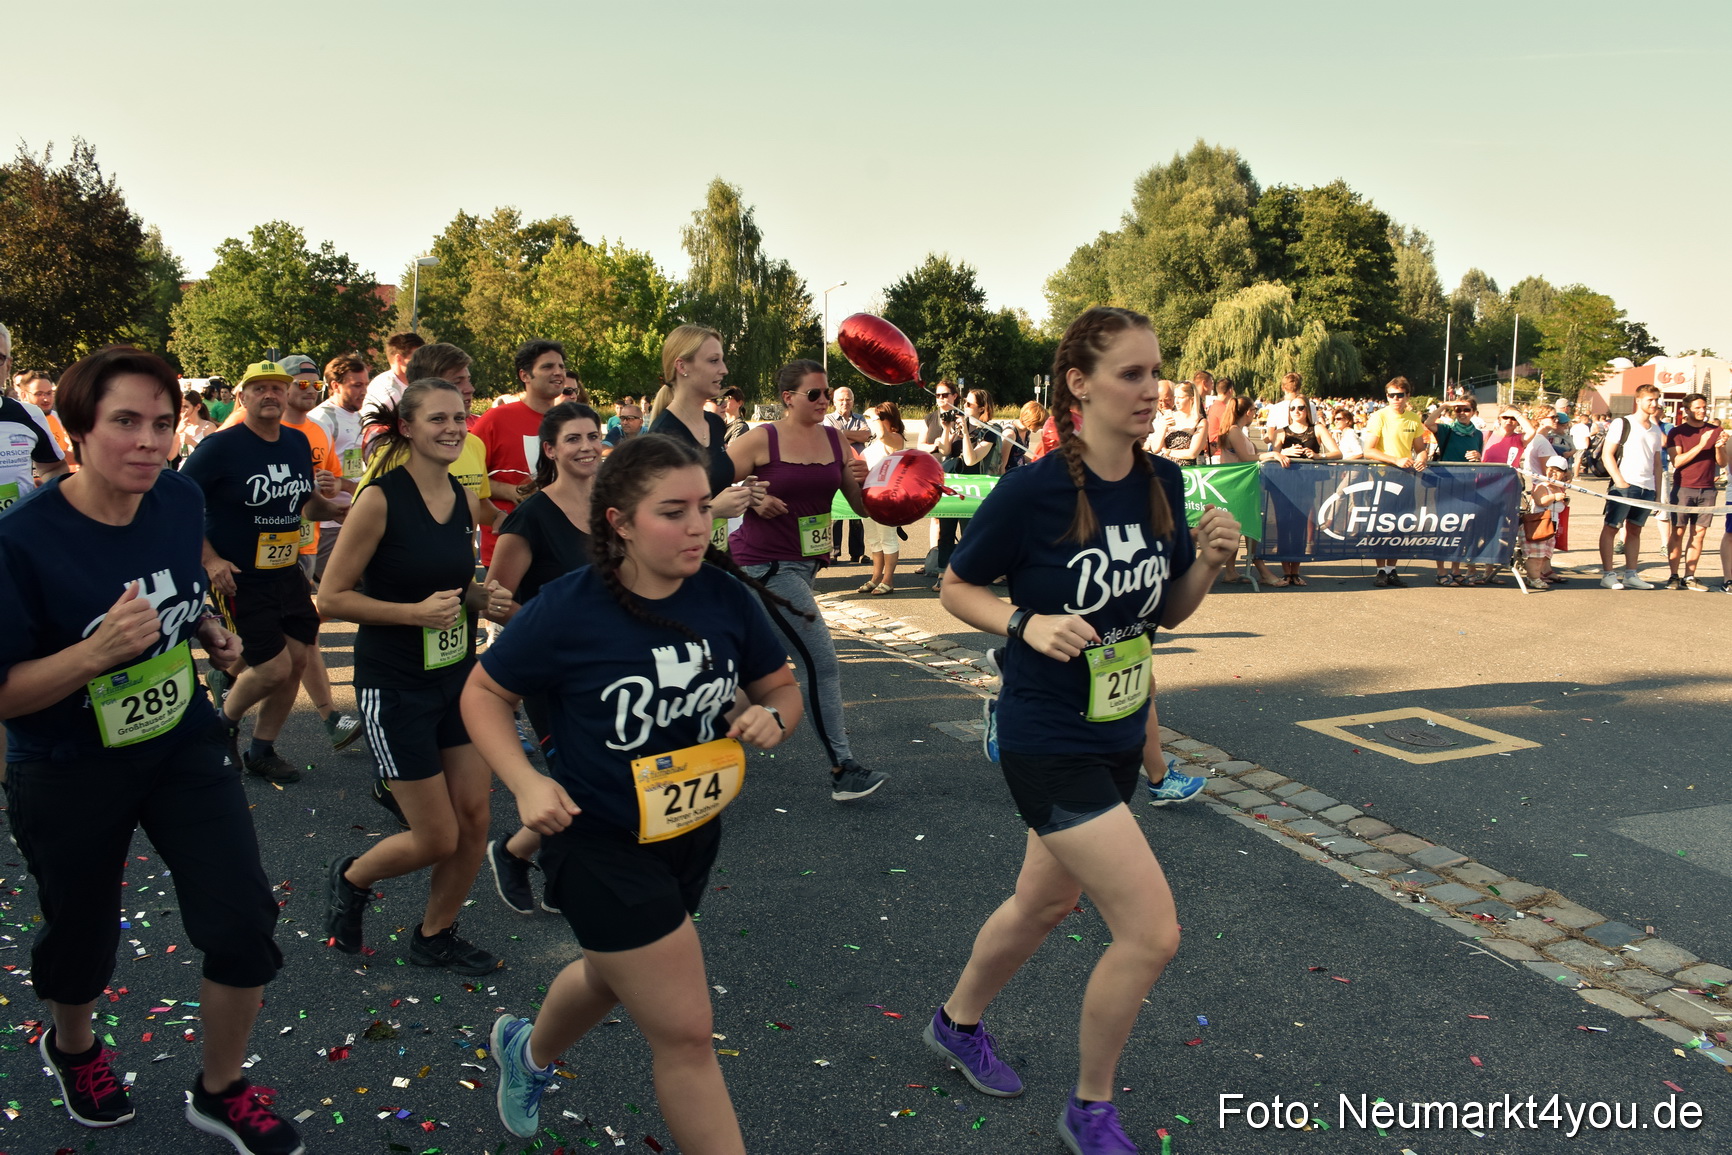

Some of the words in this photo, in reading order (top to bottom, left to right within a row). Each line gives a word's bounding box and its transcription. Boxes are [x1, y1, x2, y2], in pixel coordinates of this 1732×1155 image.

[244, 473, 313, 514] Burgis
[300, 524, 310, 538] 03
[1346, 506, 1476, 533] Fischer
[712, 527, 725, 544] 48
[1355, 536, 1462, 547] AUTOMOBILE
[268, 545, 292, 559] 273
[1063, 540, 1170, 618] Burgi
[438, 624, 465, 651] 857
[1108, 663, 1143, 700] 277
[121, 679, 179, 725] 289
[117, 712, 167, 736] Großhauser
[663, 772, 723, 816] 274
